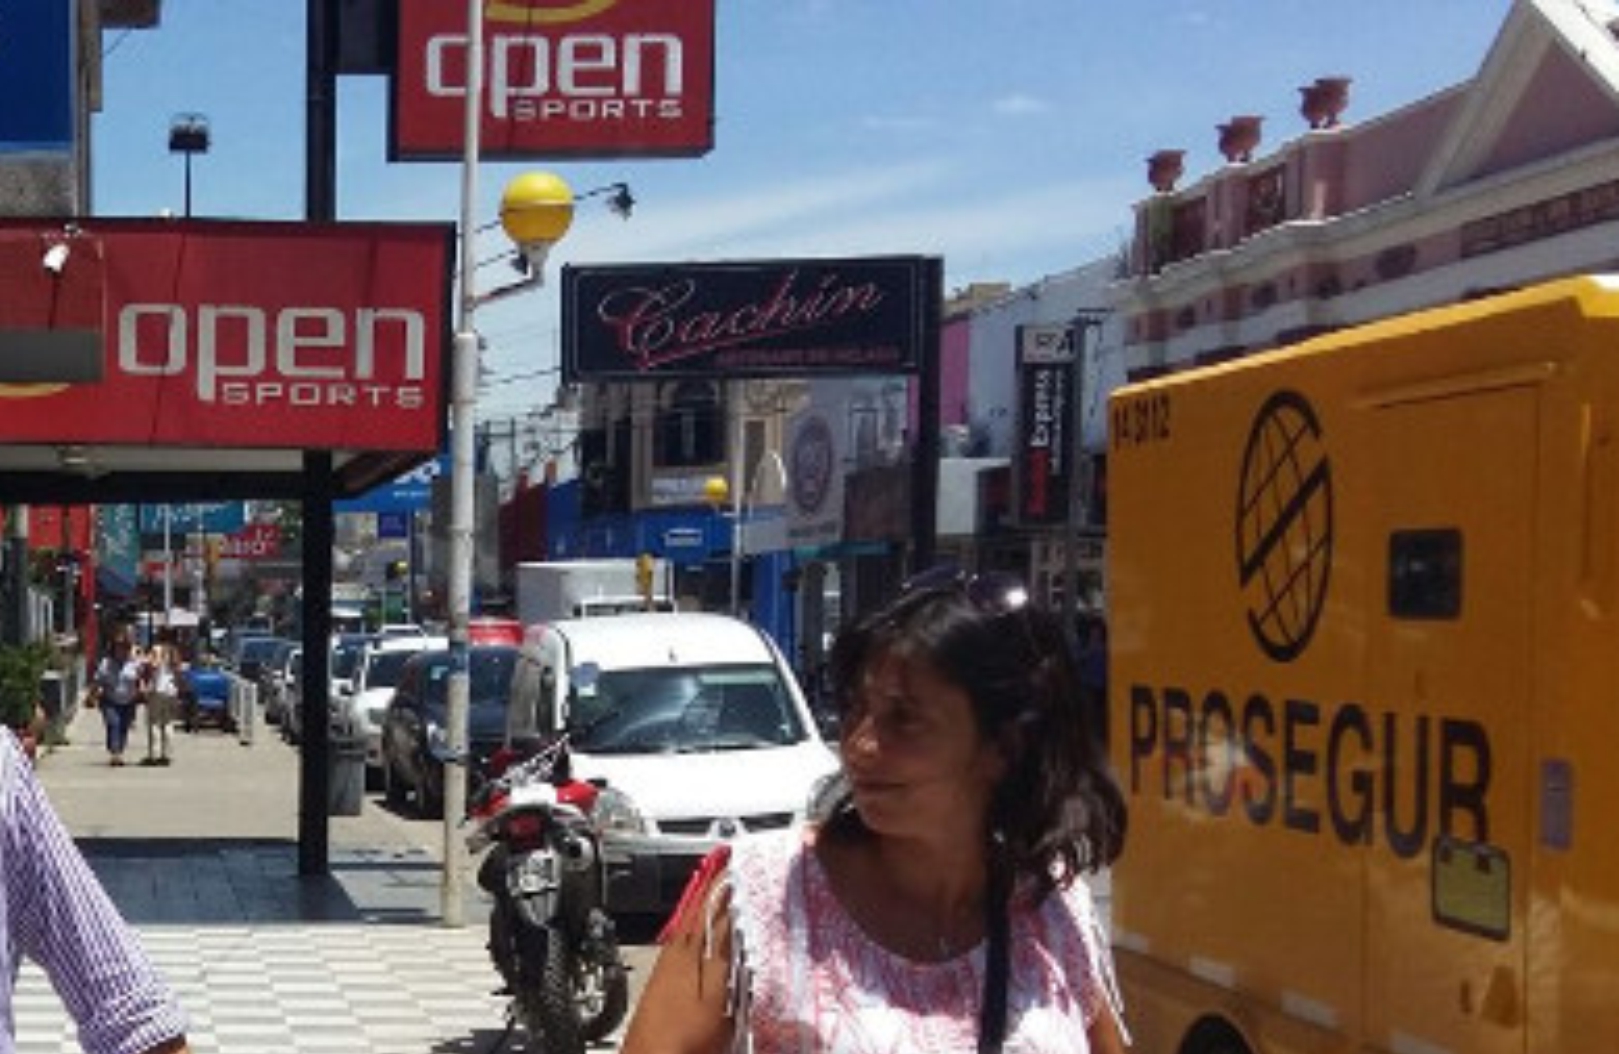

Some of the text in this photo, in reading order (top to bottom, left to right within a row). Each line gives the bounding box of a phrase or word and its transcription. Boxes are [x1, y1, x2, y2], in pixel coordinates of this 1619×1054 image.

[426, 33, 683, 119] open
[514, 99, 683, 119] SPORTS
[118, 303, 425, 402] open
[223, 382, 424, 408] SPORTS
[1130, 685, 1494, 872] PROSEGUR
